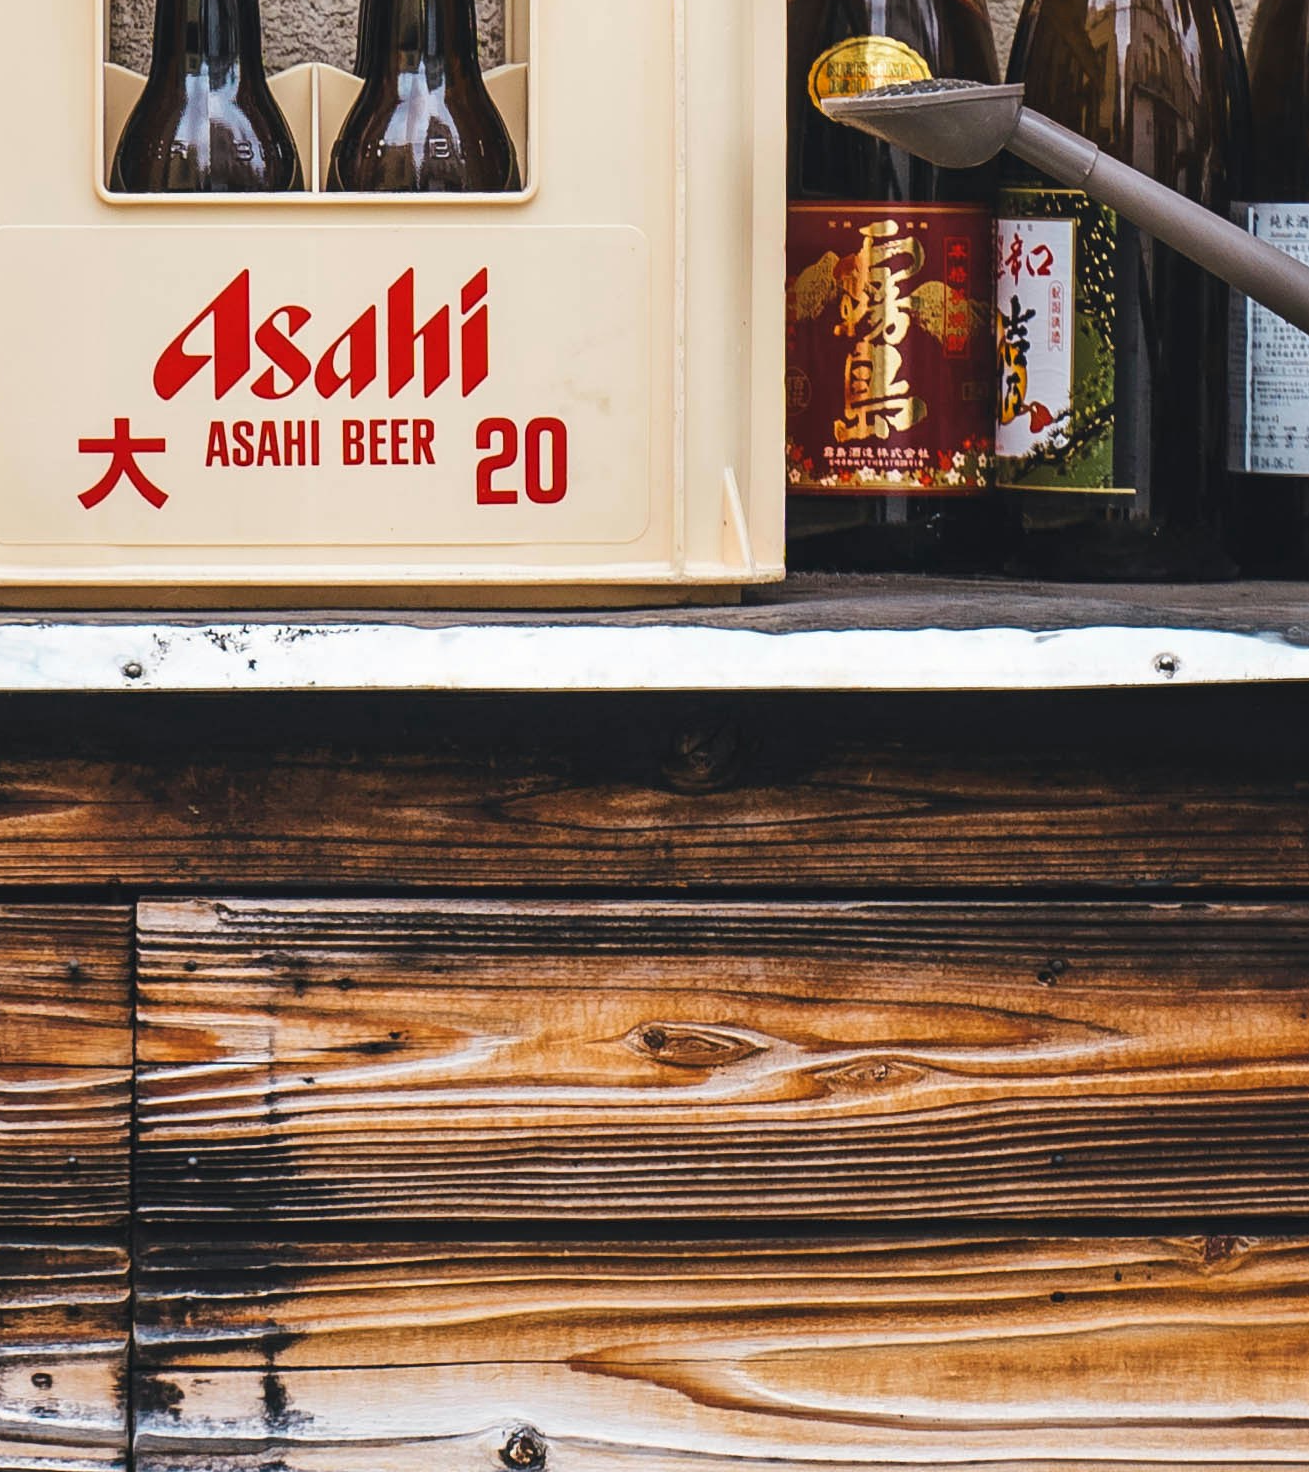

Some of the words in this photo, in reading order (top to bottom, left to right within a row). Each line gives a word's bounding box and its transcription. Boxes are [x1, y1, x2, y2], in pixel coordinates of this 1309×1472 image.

[153, 266, 489, 401] Asahi
[77, 417, 169, 511] 大
[205, 419, 320, 468] ASAHI
[342, 419, 437, 466] BEER
[475, 416, 568, 505] 20
